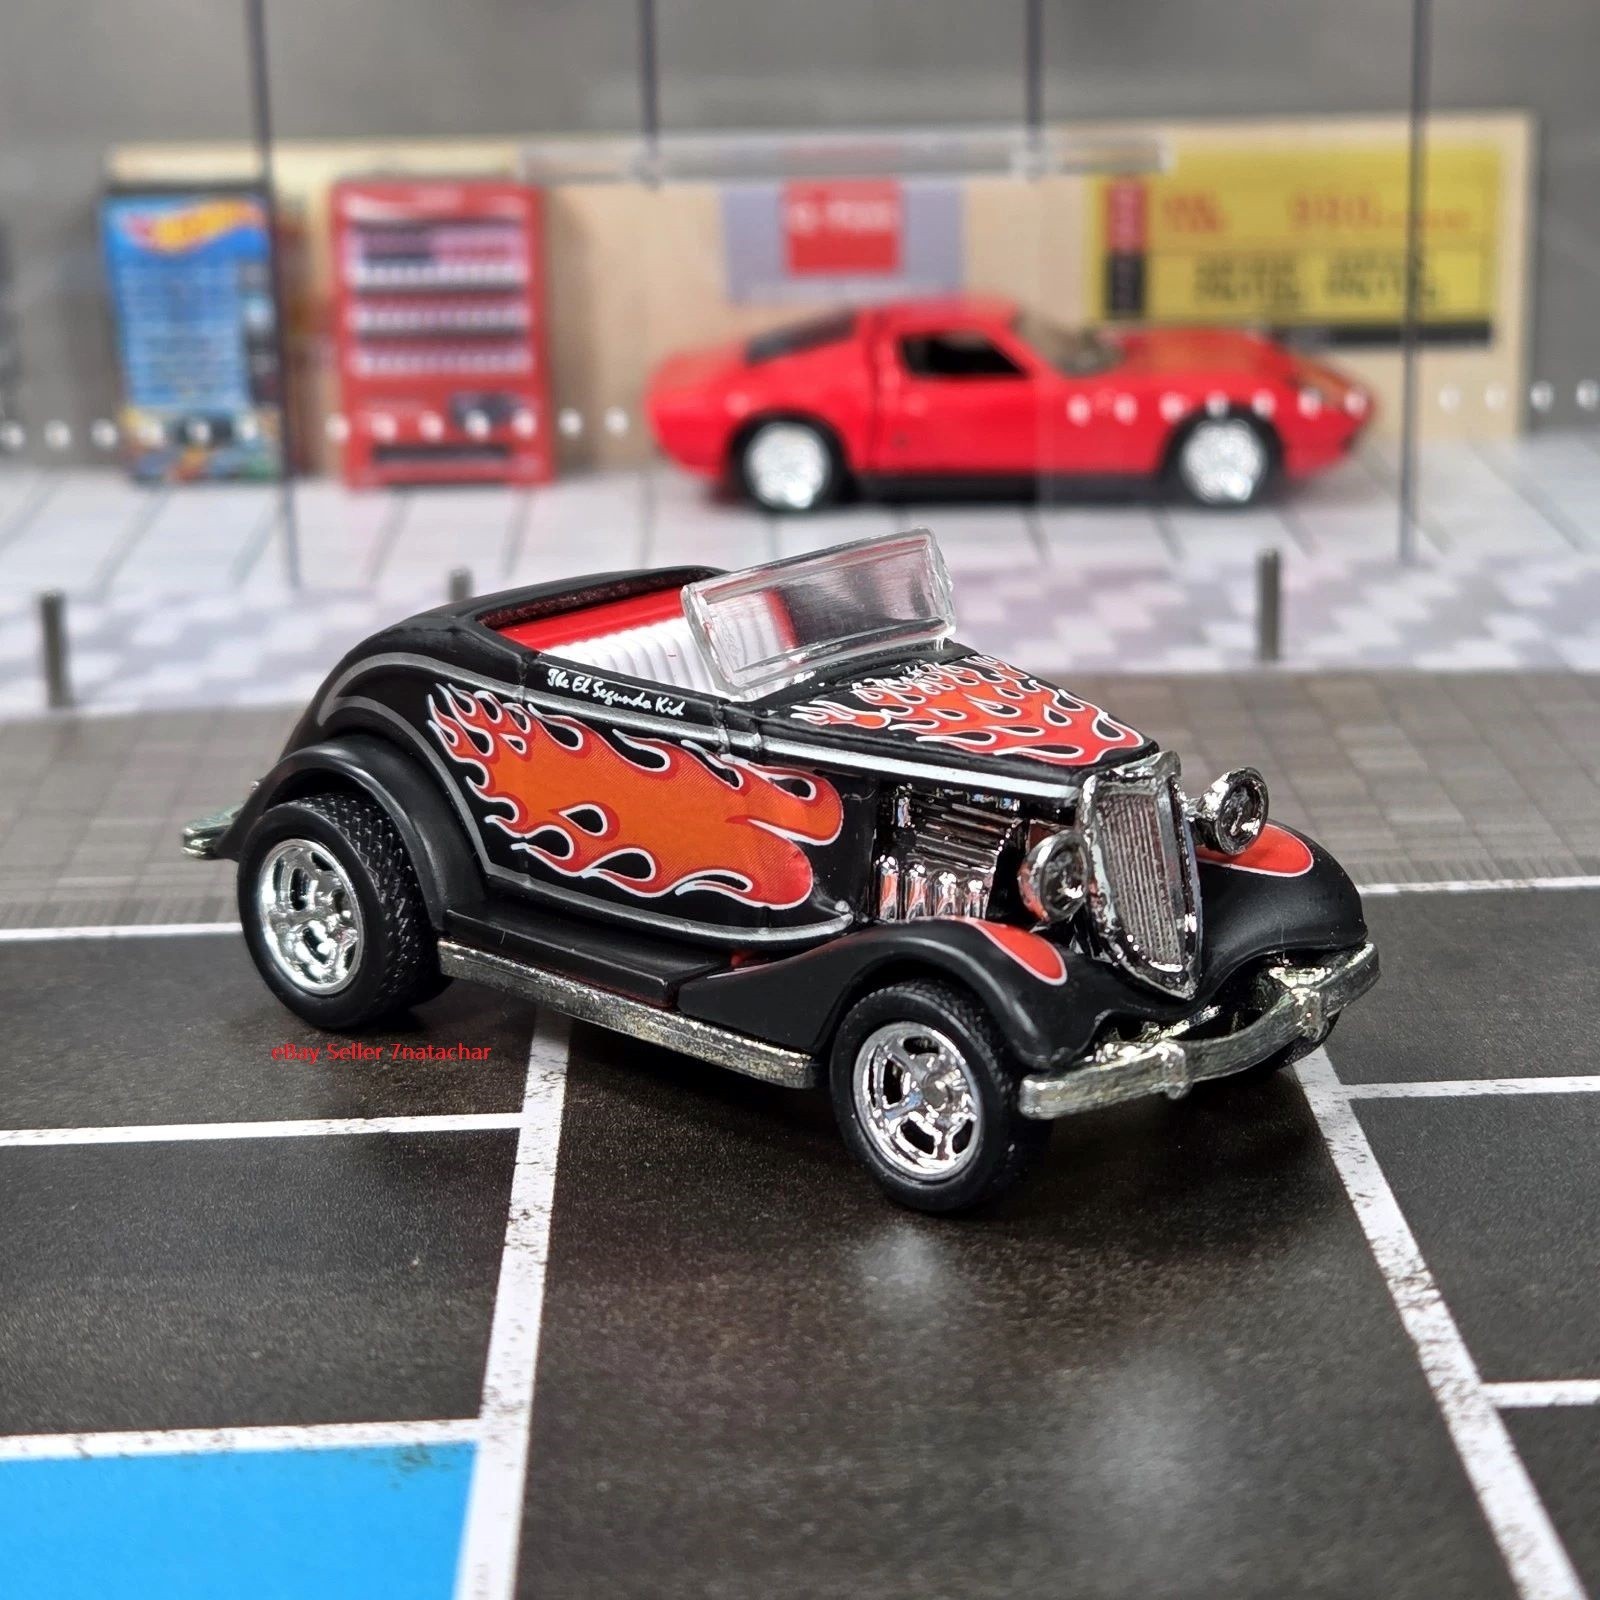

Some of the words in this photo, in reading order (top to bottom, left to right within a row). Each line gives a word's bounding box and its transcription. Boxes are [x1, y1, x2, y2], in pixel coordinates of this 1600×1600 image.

[547, 668, 569, 689] The
[572, 675, 593, 693] El
[655, 696, 686, 716] Kid
